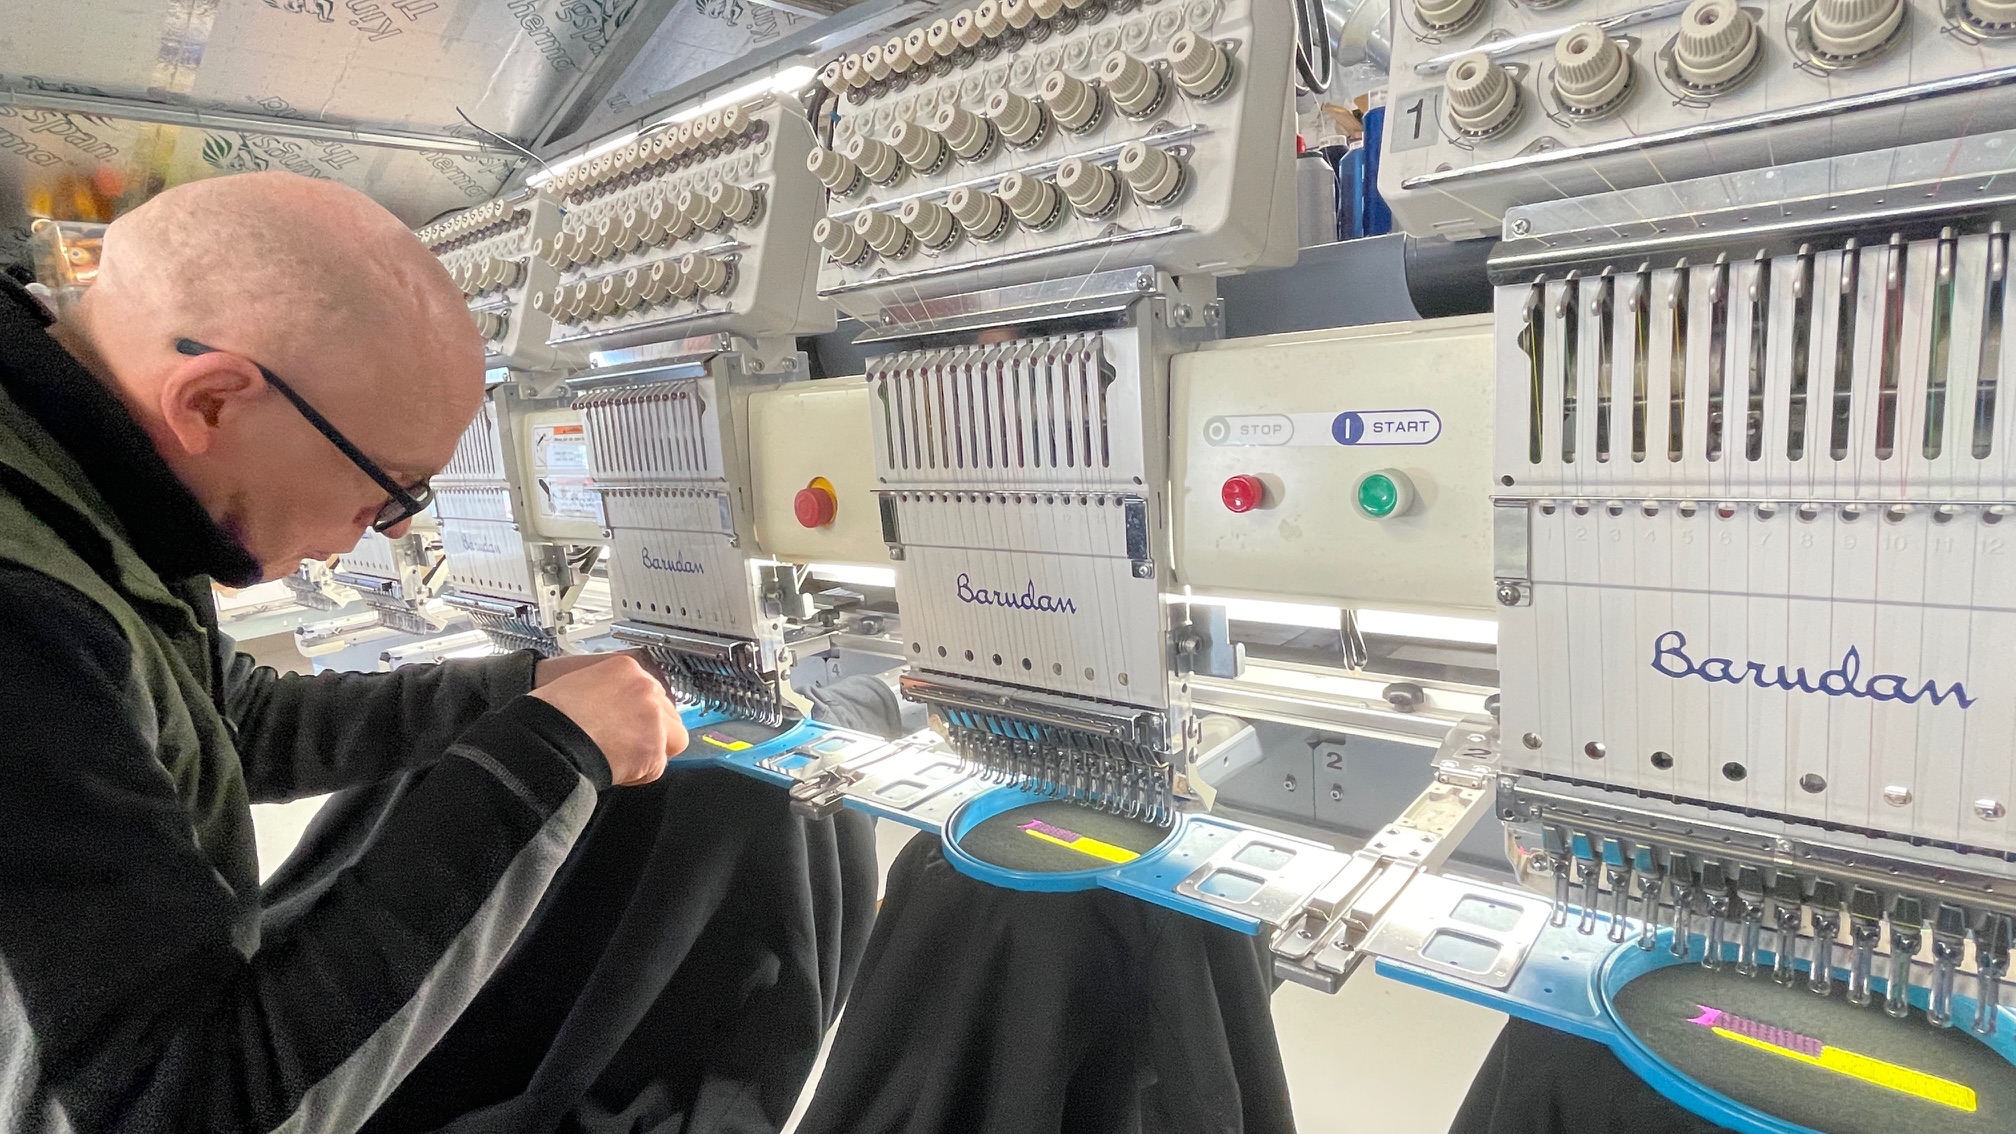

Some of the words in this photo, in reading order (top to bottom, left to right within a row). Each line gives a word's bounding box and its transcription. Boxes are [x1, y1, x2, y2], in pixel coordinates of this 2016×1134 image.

[1406, 98, 1423, 139] 1
[1240, 424, 1283, 436] STOP
[1373, 420, 1431, 433] START
[641, 547, 705, 574] Barudan
[956, 572, 1077, 614] Barudan
[832, 663, 840, 676] 4
[1651, 630, 1978, 710] Barudan
[1326, 751, 1343, 770] 2
[1462, 747, 1493, 760] 2
